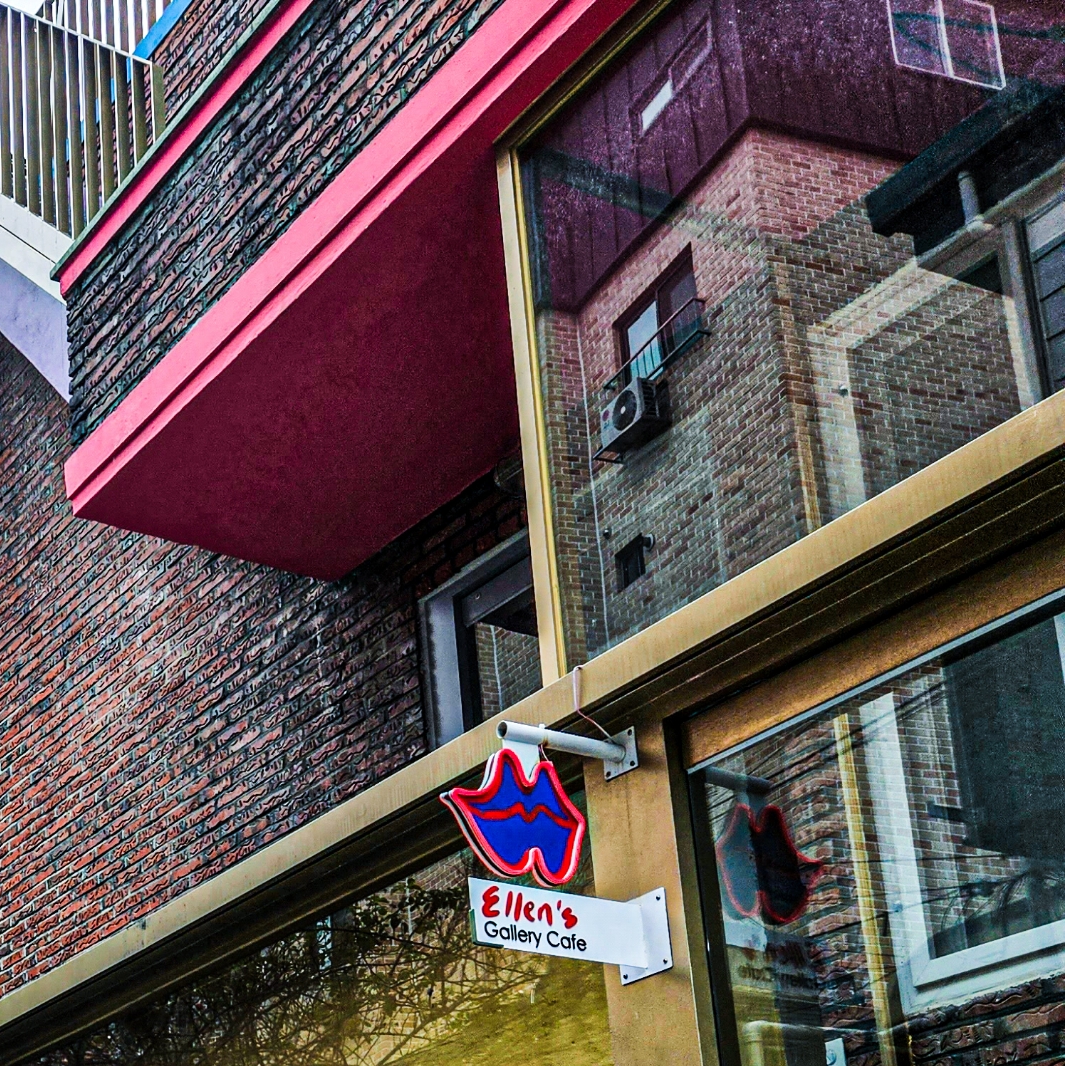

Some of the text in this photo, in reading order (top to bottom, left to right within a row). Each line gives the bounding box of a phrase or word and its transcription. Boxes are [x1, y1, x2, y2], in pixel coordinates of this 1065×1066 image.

[481, 885, 578, 930] Ellen's
[484, 920, 587, 951] Gallery Cafe
